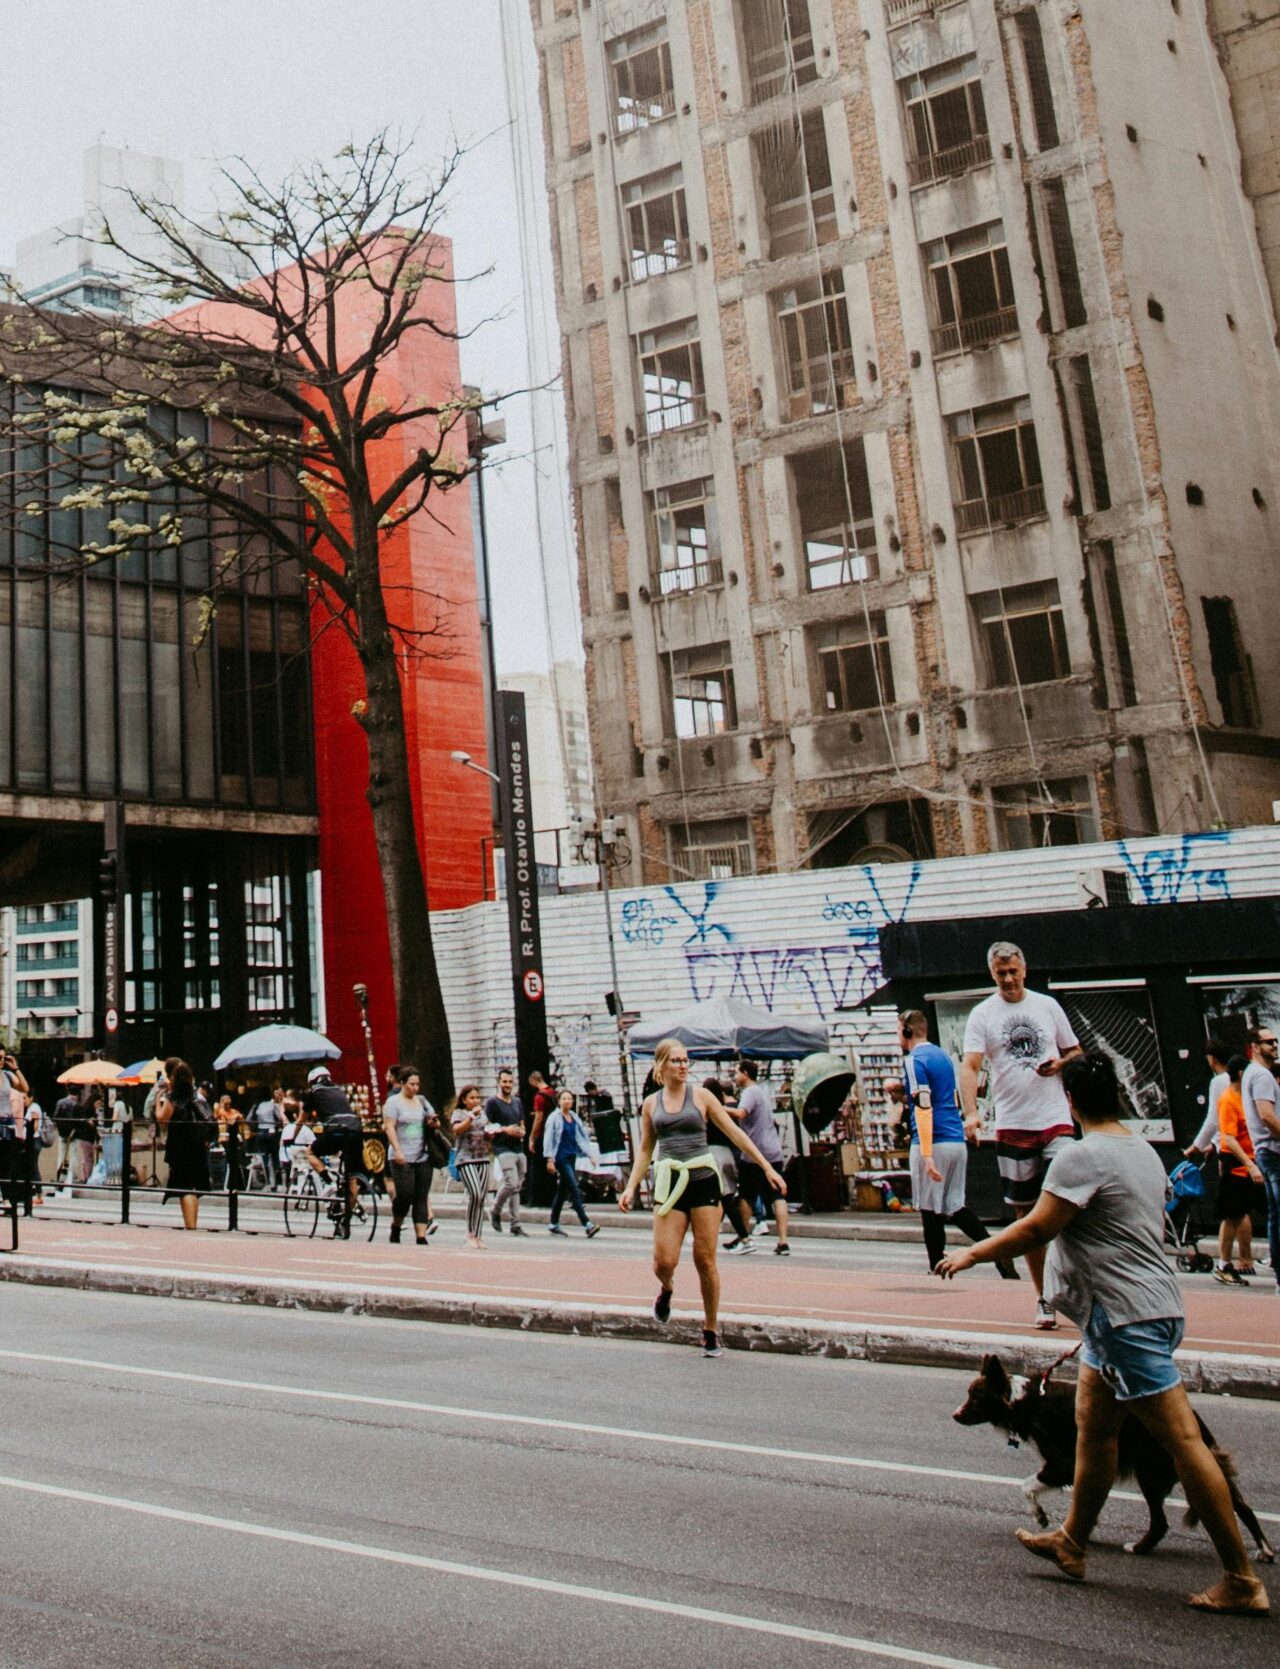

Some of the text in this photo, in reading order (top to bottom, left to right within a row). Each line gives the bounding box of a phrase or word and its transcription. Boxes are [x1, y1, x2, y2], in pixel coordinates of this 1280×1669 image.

[510, 741, 525, 814] Mendes
[519, 888, 533, 933] Prof.
[105, 912, 115, 1002] Av. Paulista
[522, 939, 534, 957] R.
